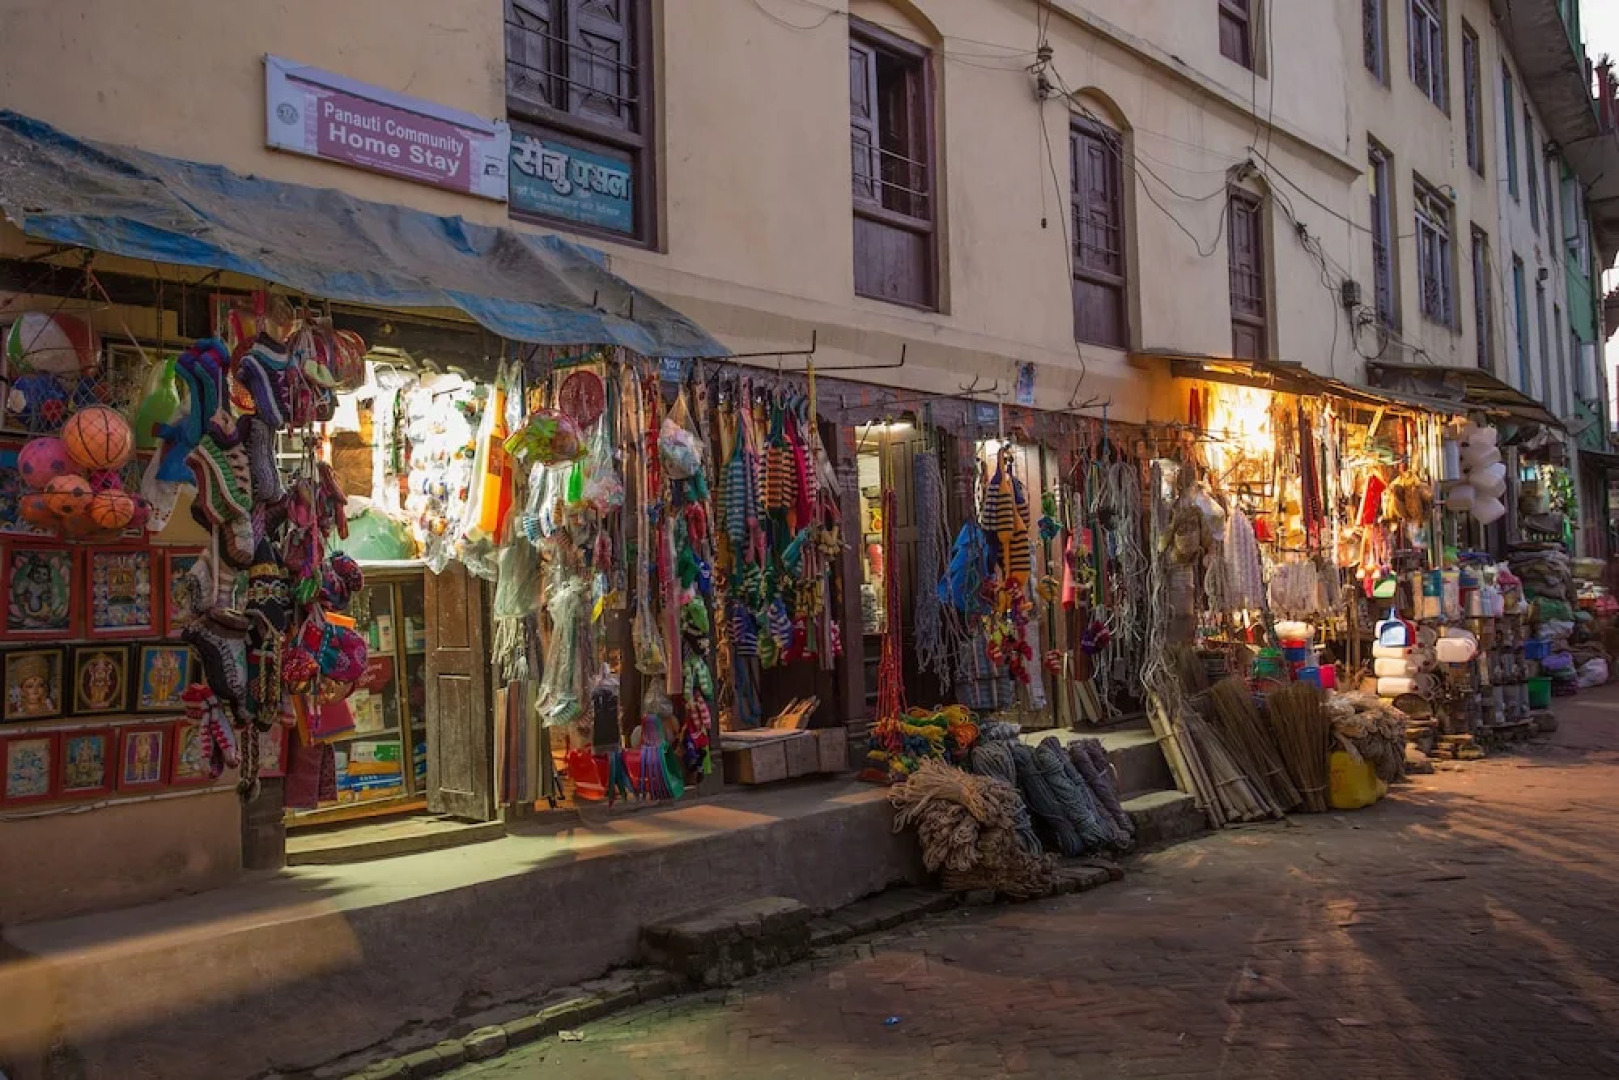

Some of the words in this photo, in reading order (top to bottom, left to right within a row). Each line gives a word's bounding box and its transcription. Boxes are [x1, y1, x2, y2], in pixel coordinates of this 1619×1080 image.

[323, 101, 382, 133] Panauti
[384, 119, 465, 157] Community
[328, 122, 401, 159] Home
[408, 145, 461, 177] Stay
